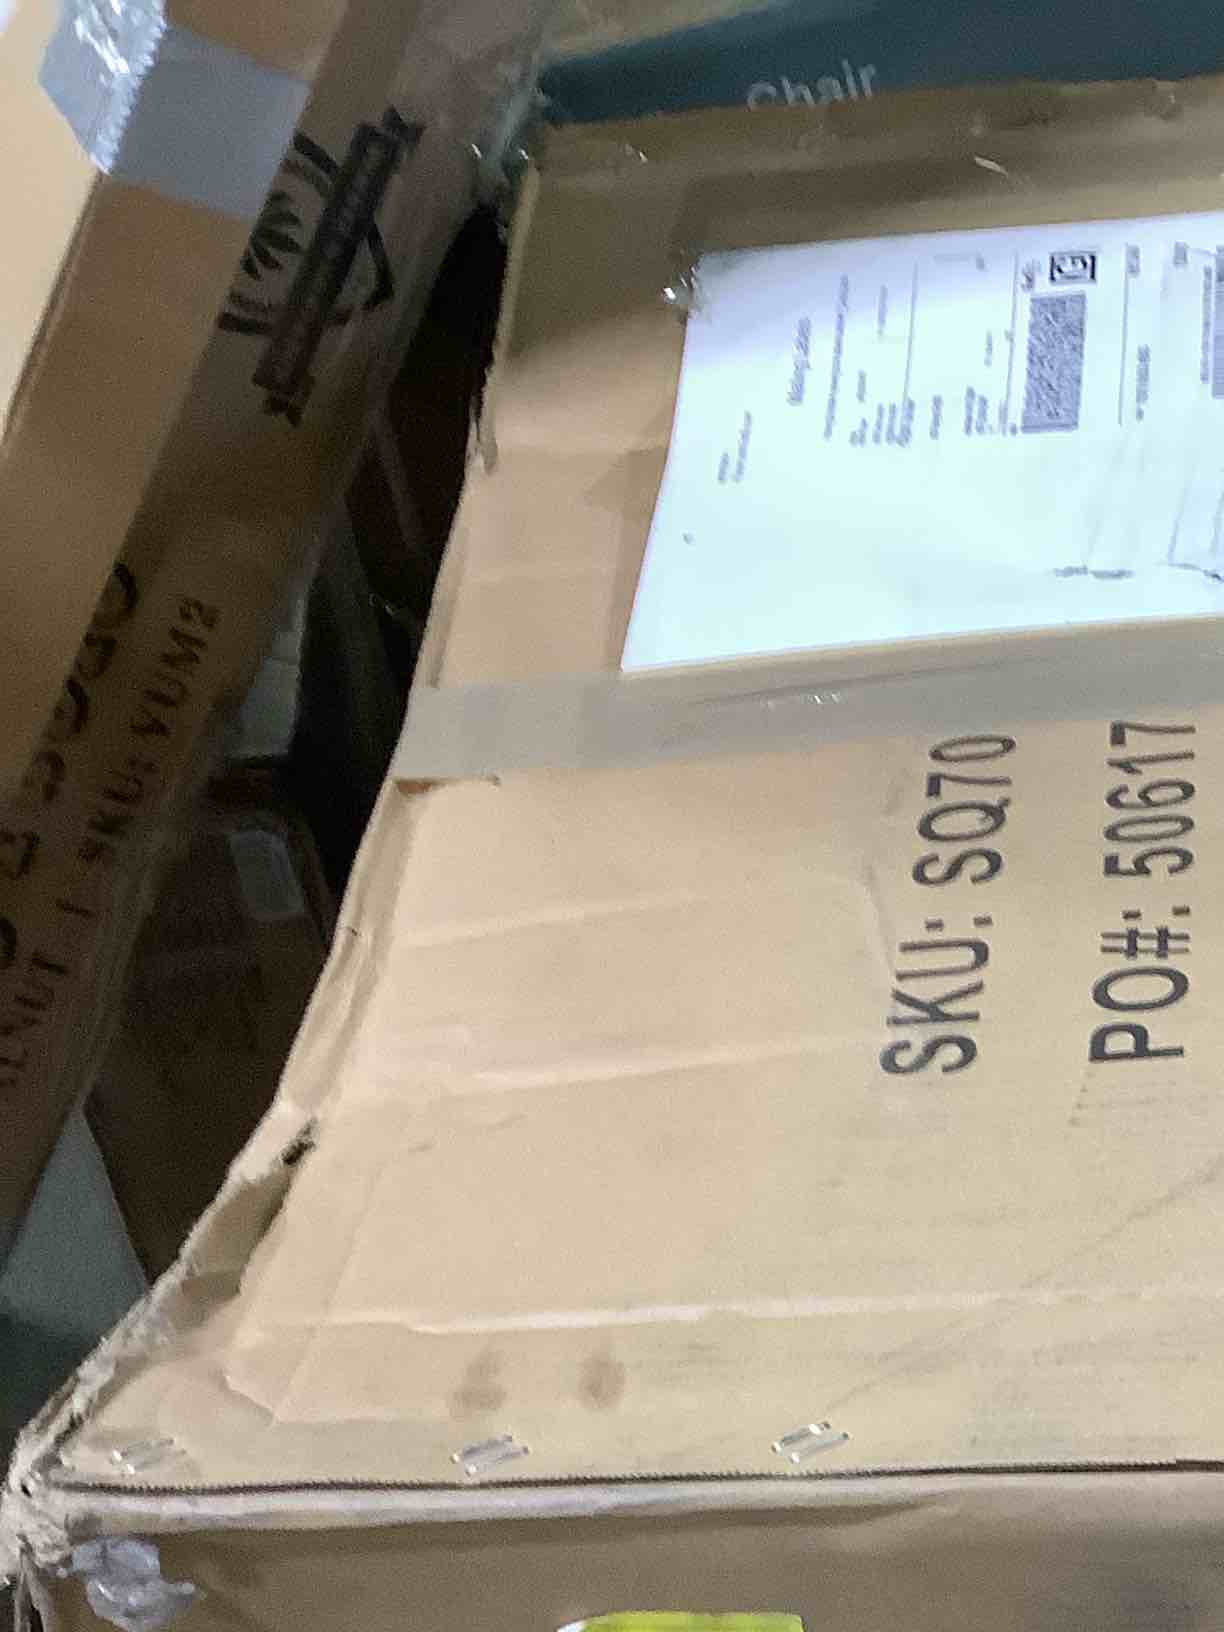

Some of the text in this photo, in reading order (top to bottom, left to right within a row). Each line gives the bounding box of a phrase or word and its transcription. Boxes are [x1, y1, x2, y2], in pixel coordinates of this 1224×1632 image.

[880, 914, 994, 1075] SKU:
[1088, 721, 1196, 1063] PO#: 50617
